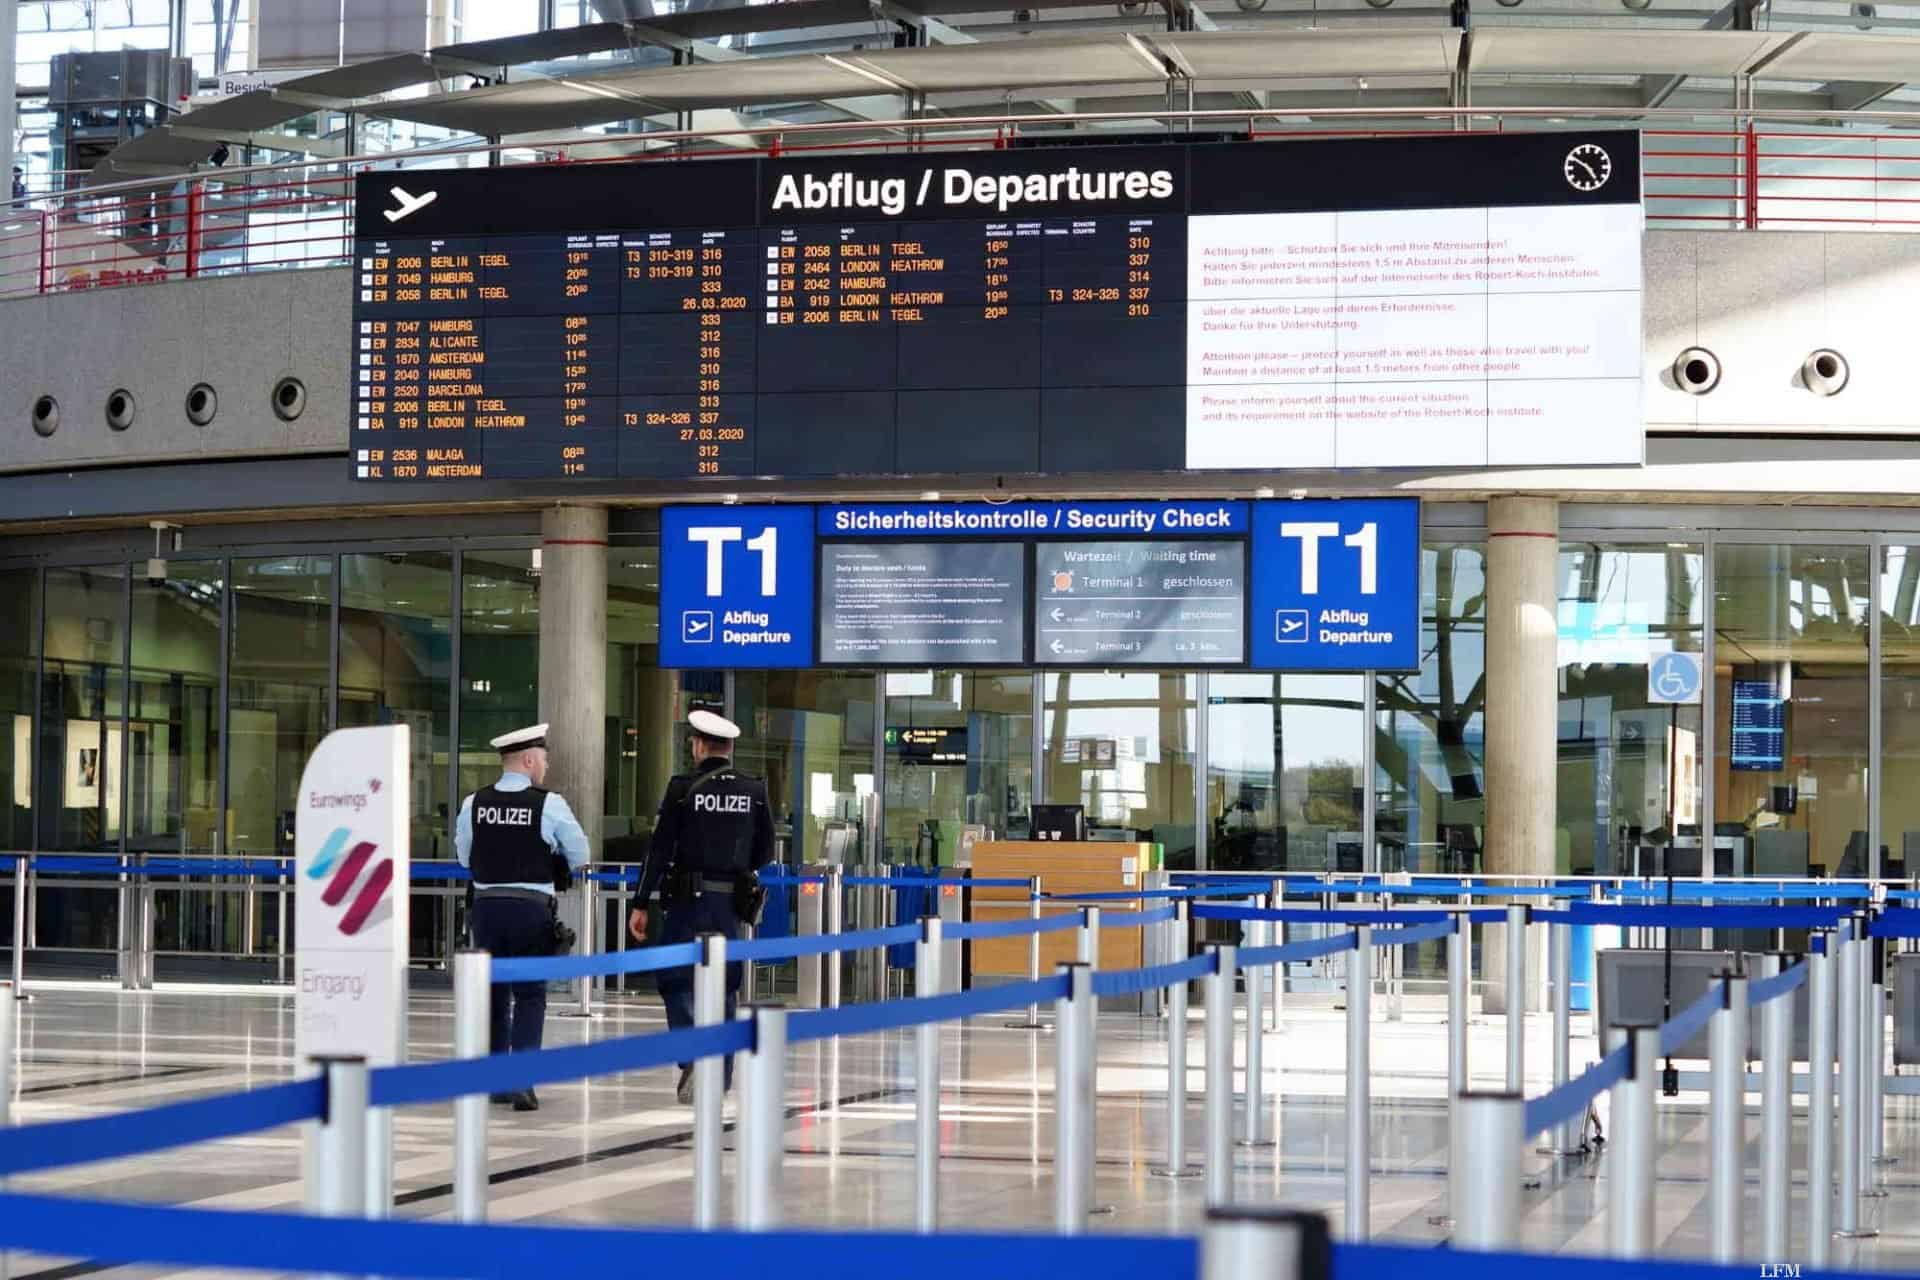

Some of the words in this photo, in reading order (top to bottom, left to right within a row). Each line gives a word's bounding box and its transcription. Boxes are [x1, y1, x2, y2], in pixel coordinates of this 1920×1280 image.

[772, 173, 905, 215] Abflug
[916, 170, 933, 206] /
[944, 168, 1173, 211] Departures
[781, 247, 795, 258] EW
[804, 246, 830, 257] 2058
[841, 245, 880, 256] BERLIN
[892, 243, 924, 254] TEGEL
[1130, 237, 1150, 248] 310
[375, 258, 388, 269] EW
[397, 257, 421, 268] 2006
[431, 256, 468, 268] BERLIN
[479, 255, 509, 266] TEGEL
[628, 251, 640, 262] T3
[649, 249, 693, 261] 310-319
[703, 249, 722, 260] 316
[781, 263, 795, 274] EW
[841, 261, 880, 272] LONDON
[891, 259, 944, 271] HEATHROW
[1130, 254, 1149, 265] 337
[375, 274, 388, 285] EW
[397, 273, 421, 284] 7049
[431, 272, 474, 283] HAMBURG
[628, 267, 640, 278] T3
[649, 266, 693, 277] 310-319
[702, 265, 721, 276] 310
[781, 279, 794, 291] EW
[804, 278, 830, 290] 2042
[841, 277, 885, 289] HAMBURG
[1129, 271, 1149, 282] 314
[375, 290, 387, 301] EW
[396, 289, 420, 300] 2058
[430, 288, 467, 300] BERLIN
[478, 287, 508, 298] TEGEL
[702, 281, 721, 293] 333
[780, 296, 794, 307] BA
[810, 295, 830, 306] 919
[841, 294, 879, 306] LONDON
[891, 293, 943, 304] HEATHROW
[1050, 290, 1063, 301] T3
[1073, 288, 1119, 300] 324-326
[1129, 288, 1149, 299] 337
[683, 297, 746, 310] 26.03.2020
[780, 312, 794, 323] EW
[803, 312, 829, 323] 2006
[840, 310, 879, 322] BERLIN
[891, 309, 922, 320] TEGEL
[1129, 304, 1149, 315] 310
[374, 322, 387, 333] EW
[397, 322, 419, 332] 7047
[430, 320, 472, 332] HAMBURG
[701, 314, 720, 325] 333
[373, 338, 386, 349] EW
[430, 336, 478, 348] ALICANTE
[701, 331, 720, 341] 312
[373, 355, 385, 365] KL
[396, 354, 420, 364] 1870
[429, 352, 484, 364] AMSTERDAM
[701, 347, 720, 358] 316
[1343, 348, 1387, 360] yourself
[373, 370, 386, 381] EW
[395, 369, 419, 380] 2040
[429, 368, 472, 380] HAMBURG
[700, 363, 720, 374] 310
[372, 386, 385, 397] EW
[394, 386, 419, 396] 2520
[428, 384, 483, 396] BARCELONA
[700, 380, 720, 391] 316
[372, 402, 385, 413] EW
[394, 401, 418, 412] 2006
[428, 400, 464, 412] BERLIN
[476, 400, 506, 411] TEGEL
[700, 396, 719, 407] 313
[371, 418, 384, 429] BA
[400, 418, 418, 428] 919
[428, 417, 464, 428] LONDON
[475, 416, 525, 427] HEATHROW
[624, 414, 637, 424] T3
[646, 413, 690, 424] 324-326
[700, 412, 719, 423] 337
[681, 429, 743, 441] 27.03.2020
[371, 450, 384, 461] EW
[392, 450, 417, 461] 2536
[426, 449, 464, 460] MALAGA
[699, 446, 719, 457] 312
[370, 466, 383, 477] KL
[394, 466, 417, 477] 1870
[427, 465, 481, 476] AMSTERDAM
[699, 462, 718, 473] 316
[835, 511, 1048, 530] Sicherheitskontrolle
[1054, 509, 1062, 529] /
[1067, 509, 1157, 532] Security
[1163, 508, 1231, 528] Check
[688, 527, 777, 597] T1
[1064, 550, 1120, 562] Wartezeit
[1140, 551, 1187, 563] Waiting
[1189, 550, 1217, 561] time
[1281, 522, 1377, 595] T1
[1082, 576, 1134, 588] Terminal
[1136, 576, 1145, 587] 1
[1163, 576, 1233, 589] geschlossen
[723, 611, 769, 627] Abflug
[1095, 610, 1133, 619] Terminal
[1319, 609, 1369, 627] Abflug
[723, 629, 791, 646] Departure
[1095, 641, 1133, 650] Terminal
[1319, 629, 1393, 646] Departure
[310, 792, 367, 812] Eurowings
[695, 794, 751, 812] POLIZEI
[477, 807, 532, 826] POLIZEI
